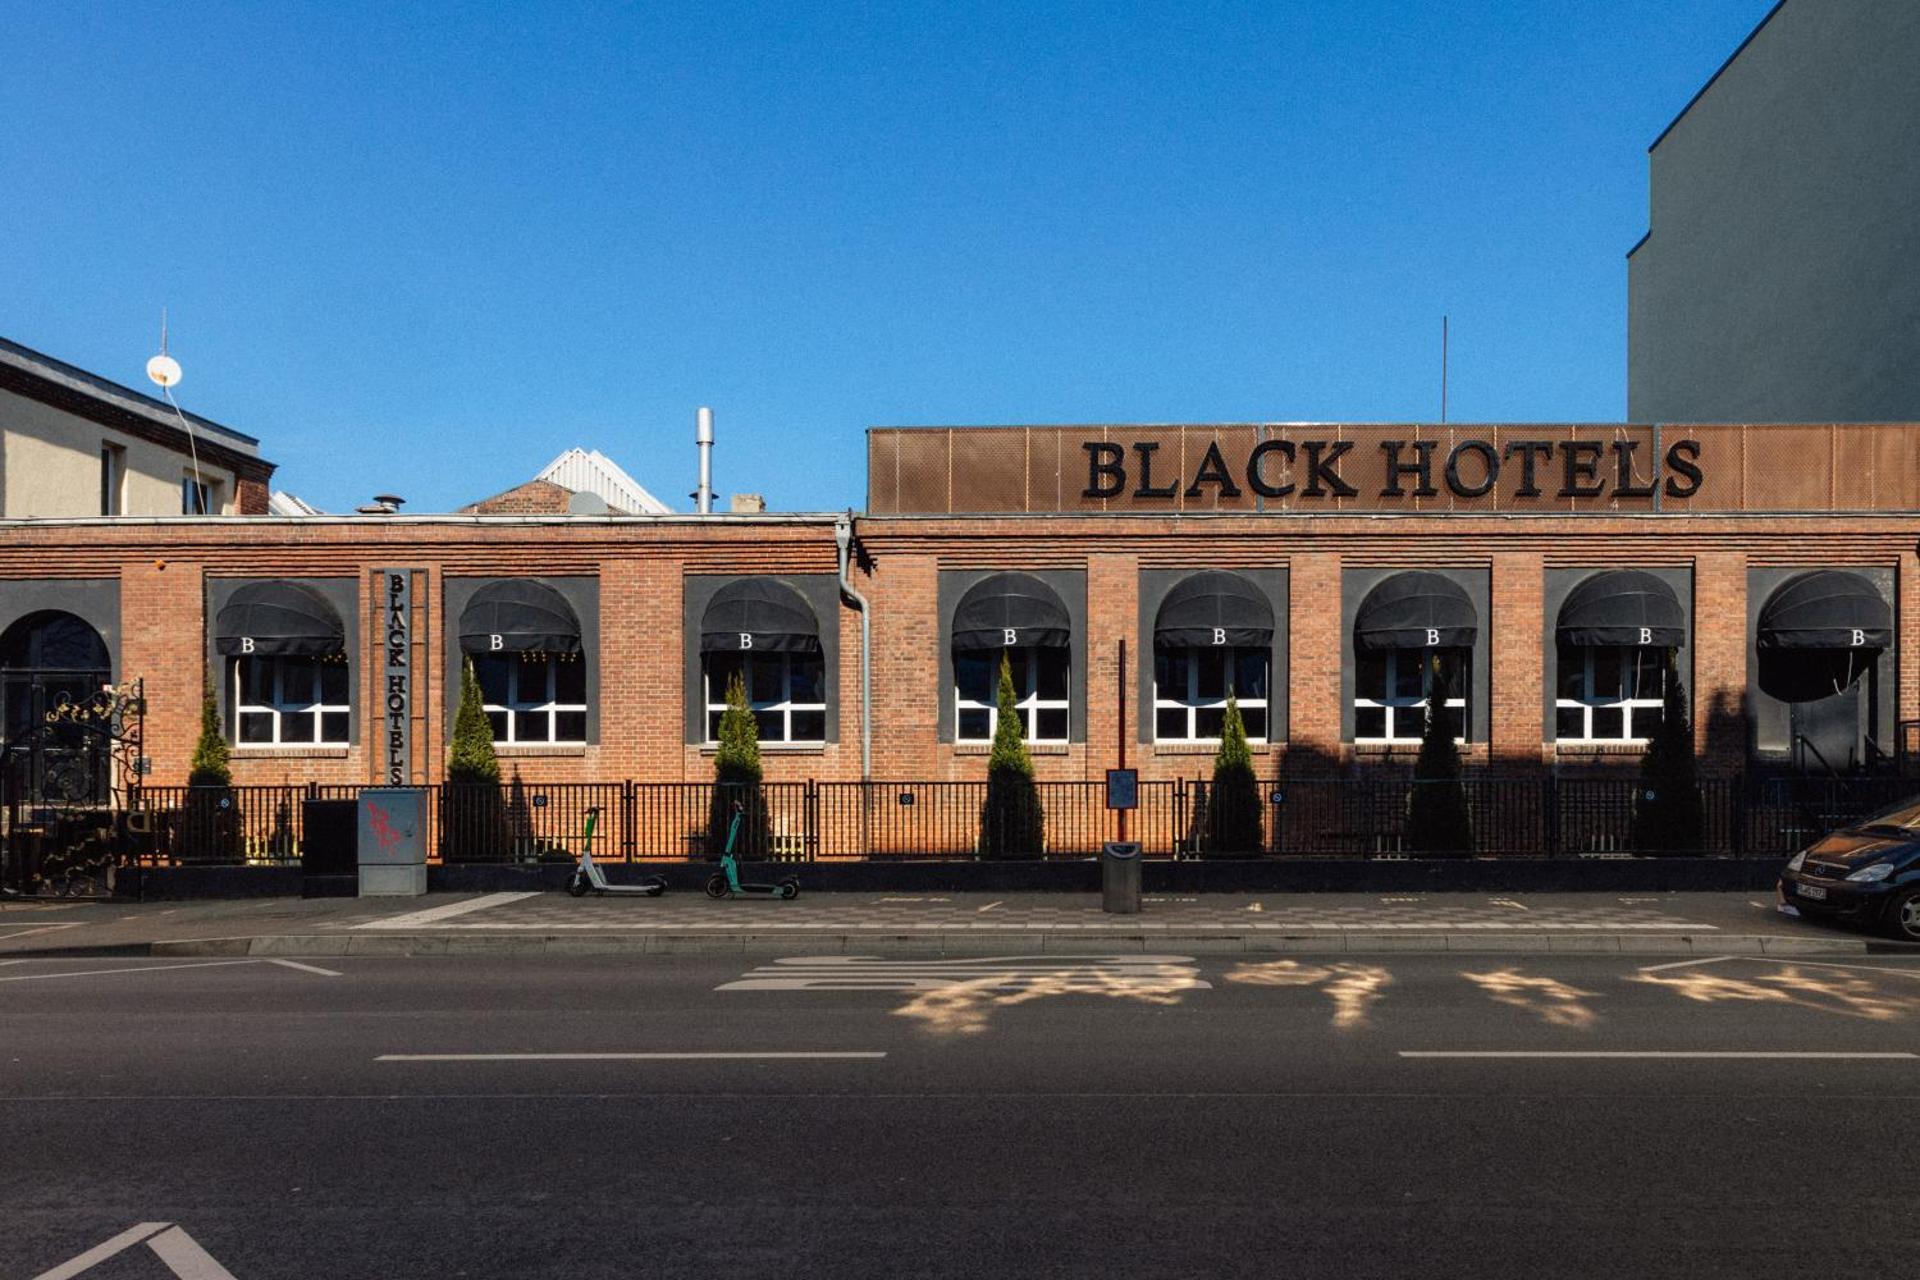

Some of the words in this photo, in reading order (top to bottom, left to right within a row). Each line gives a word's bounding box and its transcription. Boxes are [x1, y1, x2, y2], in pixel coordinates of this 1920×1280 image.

[1081, 441, 1356, 498] BLACK
[1380, 441, 1704, 498] HOTELS
[388, 574, 406, 667] BLACK
[242, 636, 254, 653] B
[490, 635, 503, 651] B
[739, 633, 752, 649] B
[1004, 628, 1019, 645] B
[1212, 628, 1226, 645] B
[1425, 628, 1440, 645] B
[1638, 628, 1652, 645] B
[1851, 629, 1865, 646] B
[388, 675, 406, 786] HOTELS
